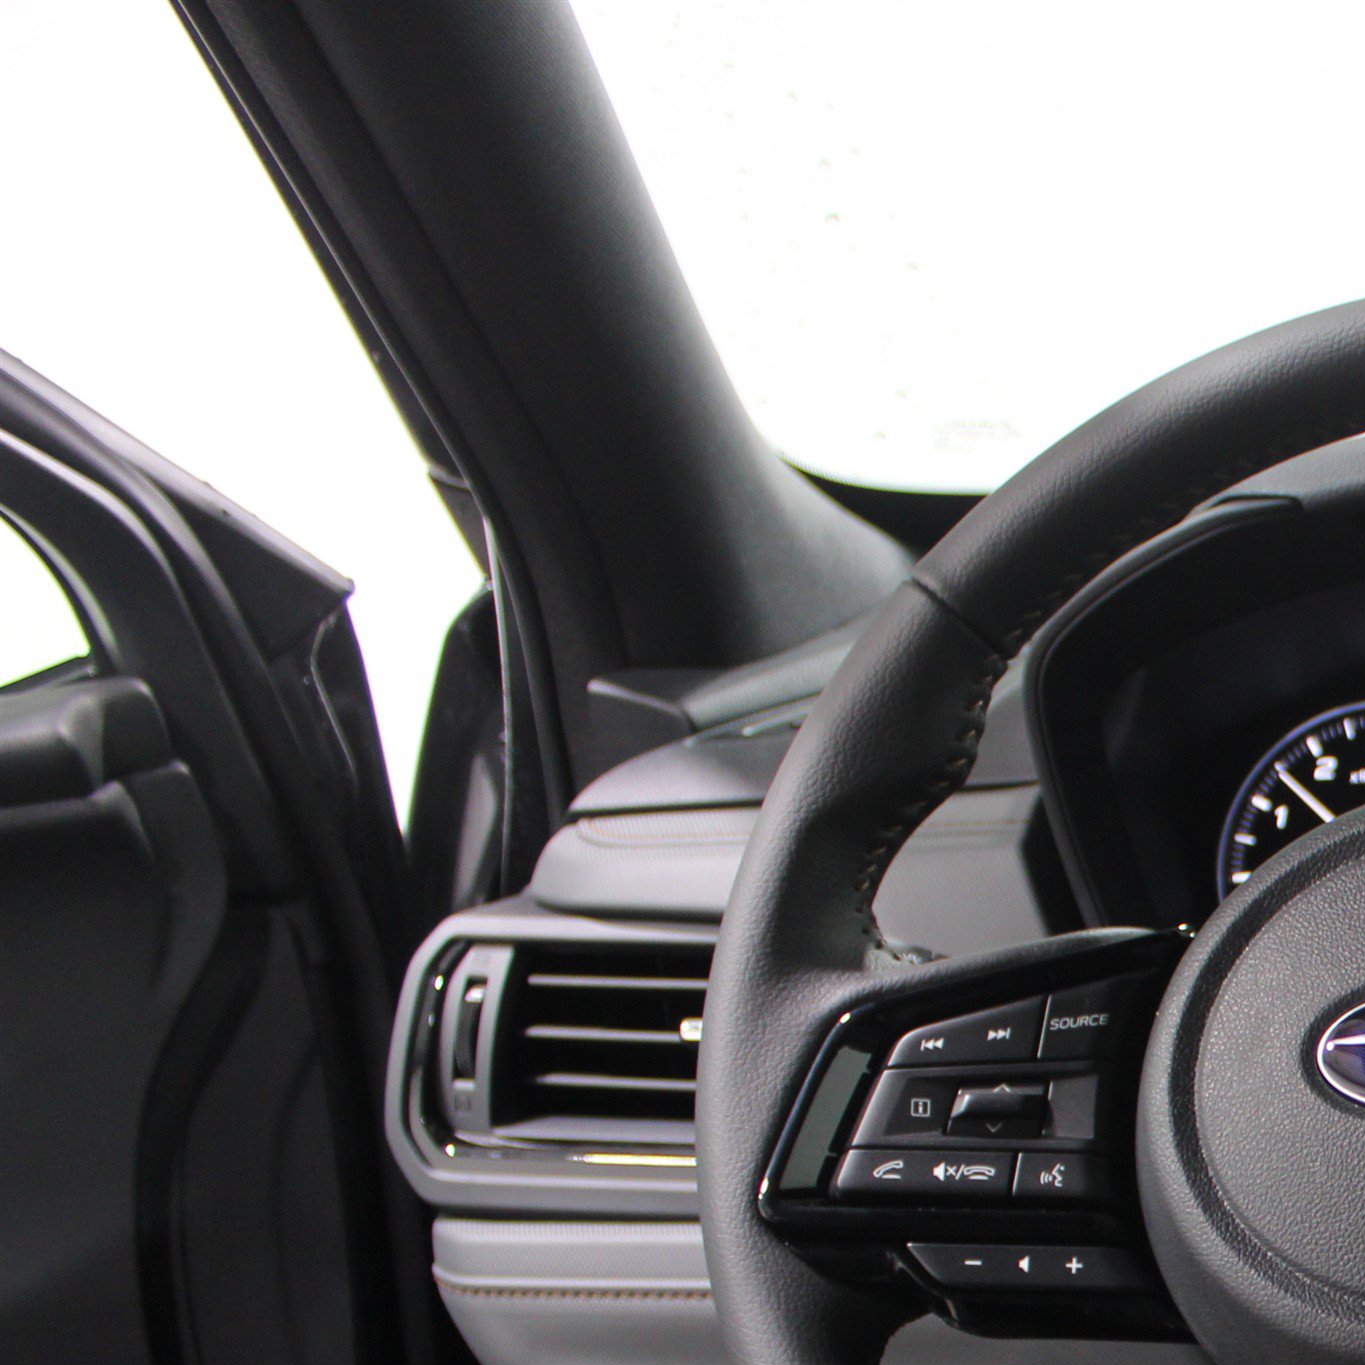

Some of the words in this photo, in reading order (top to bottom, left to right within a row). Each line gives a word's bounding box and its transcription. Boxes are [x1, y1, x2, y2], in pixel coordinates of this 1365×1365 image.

[1314, 756, 1338, 780] 2
[1274, 805, 1289, 830] 1
[1049, 1012, 1109, 1031] SOURCE
